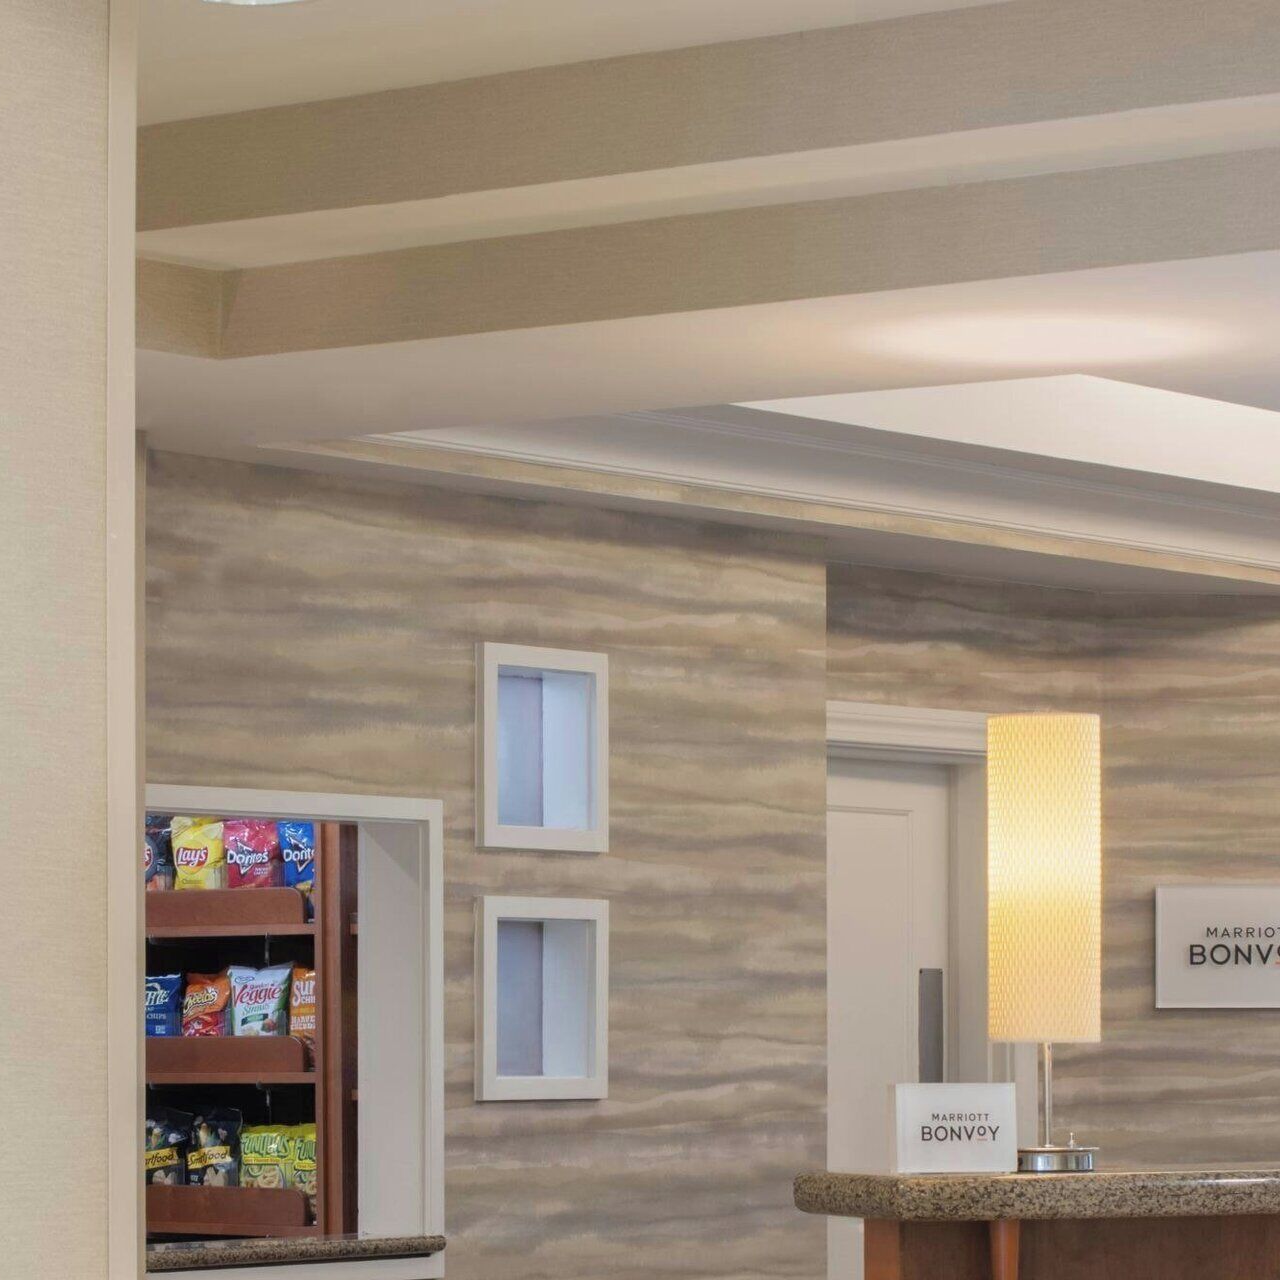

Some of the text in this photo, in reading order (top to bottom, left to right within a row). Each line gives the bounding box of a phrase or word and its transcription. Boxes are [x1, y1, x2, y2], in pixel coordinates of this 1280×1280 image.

[177, 847, 207, 867] Lay's
[227, 850, 268, 865] Doritos
[232, 984, 280, 1008] Veggie
[931, 1113, 989, 1122] MARRIOTT
[921, 1126, 999, 1141] BONVOY
